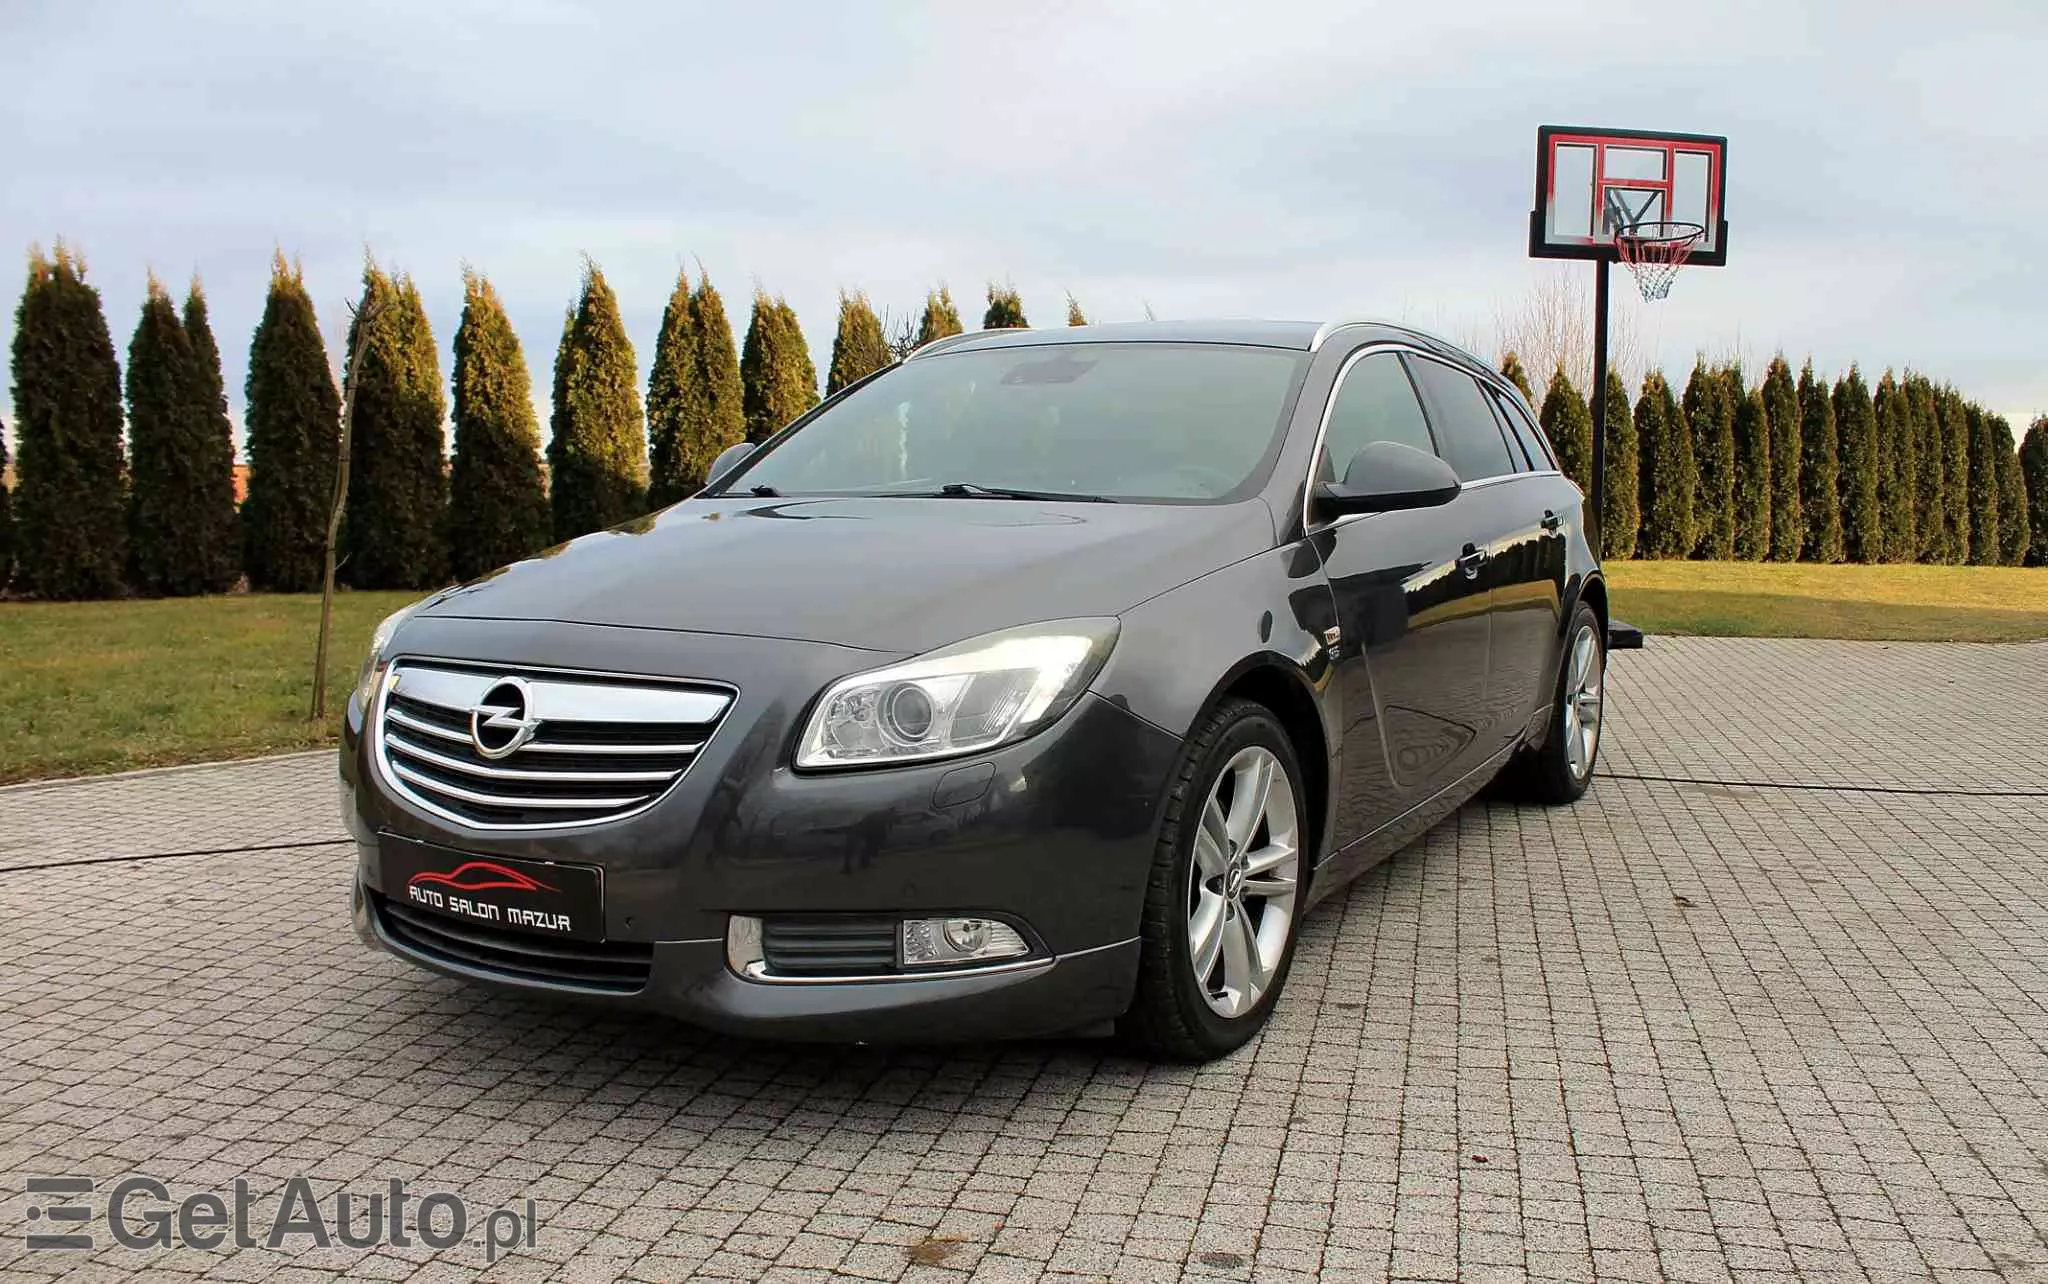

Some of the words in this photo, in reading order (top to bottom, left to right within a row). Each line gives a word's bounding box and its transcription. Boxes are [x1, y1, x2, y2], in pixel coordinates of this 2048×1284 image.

[409, 886, 444, 908] AUTO
[449, 896, 500, 921] SALON
[507, 907, 571, 932] MAZUR
